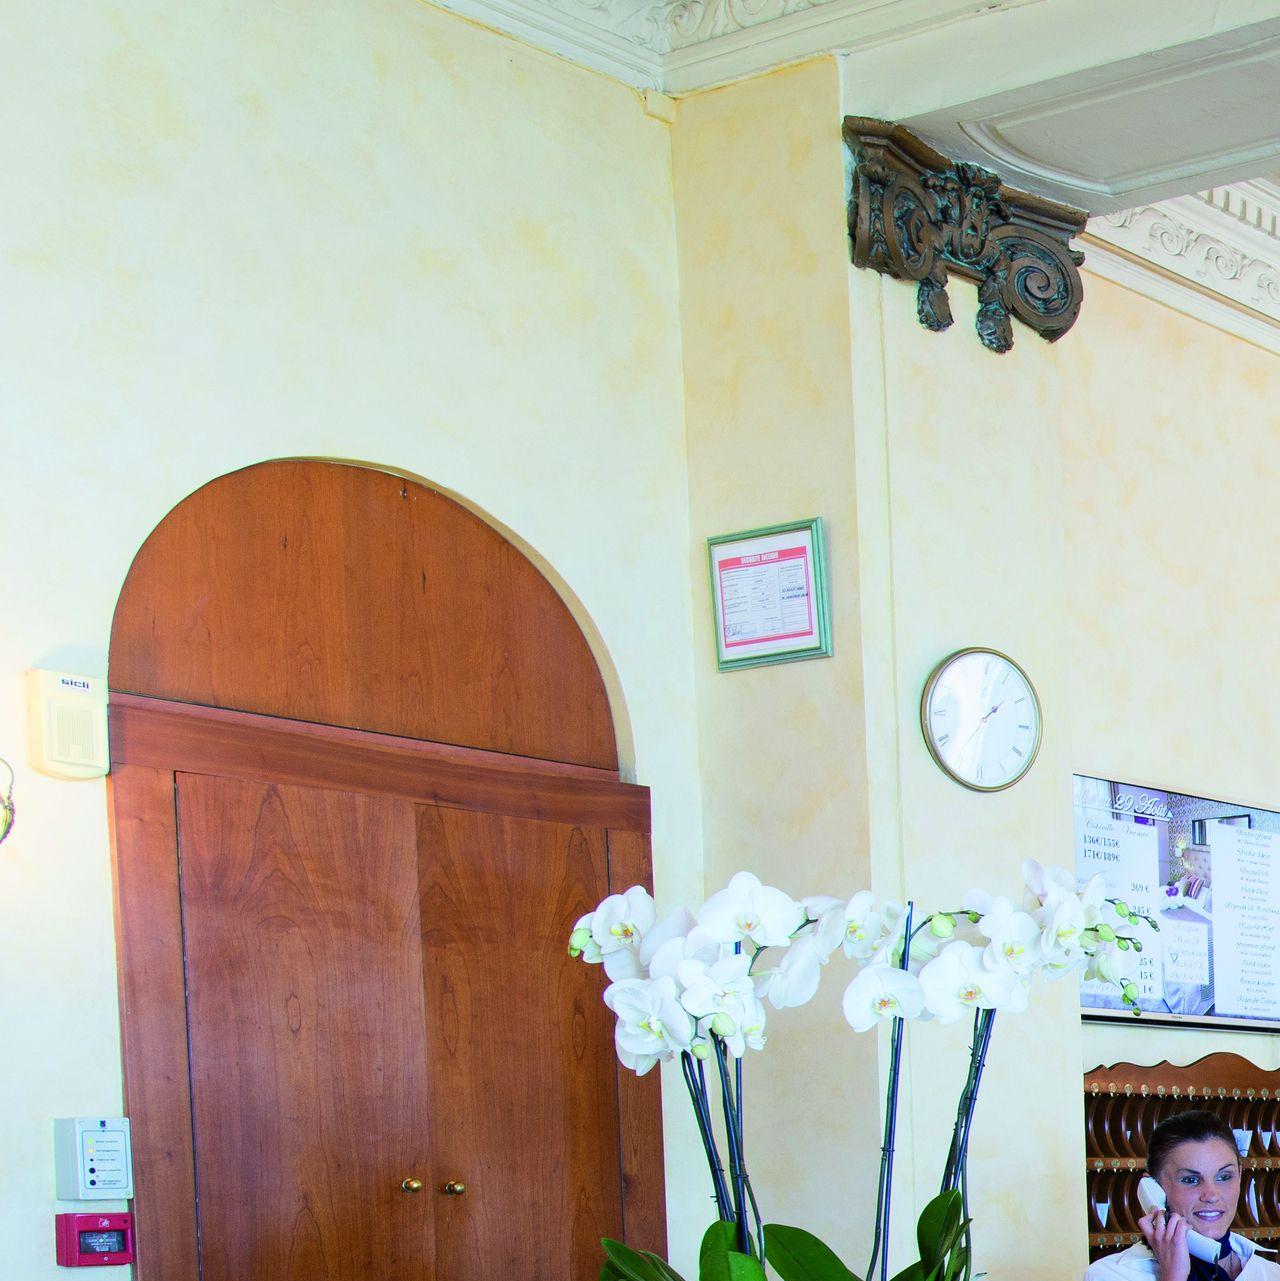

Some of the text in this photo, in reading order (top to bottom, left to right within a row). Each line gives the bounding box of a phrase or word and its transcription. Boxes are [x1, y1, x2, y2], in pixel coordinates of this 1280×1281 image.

[1114, 793, 1134, 811] 29
[1135, 793, 1167, 817] Août
[1083, 834, 1121, 849] 136€/155€
[1083, 848, 1121, 863] 171€/189€
[1131, 882, 1144, 893] 269
[1139, 957, 1148, 966] 25
[1140, 971, 1148, 979] 15
